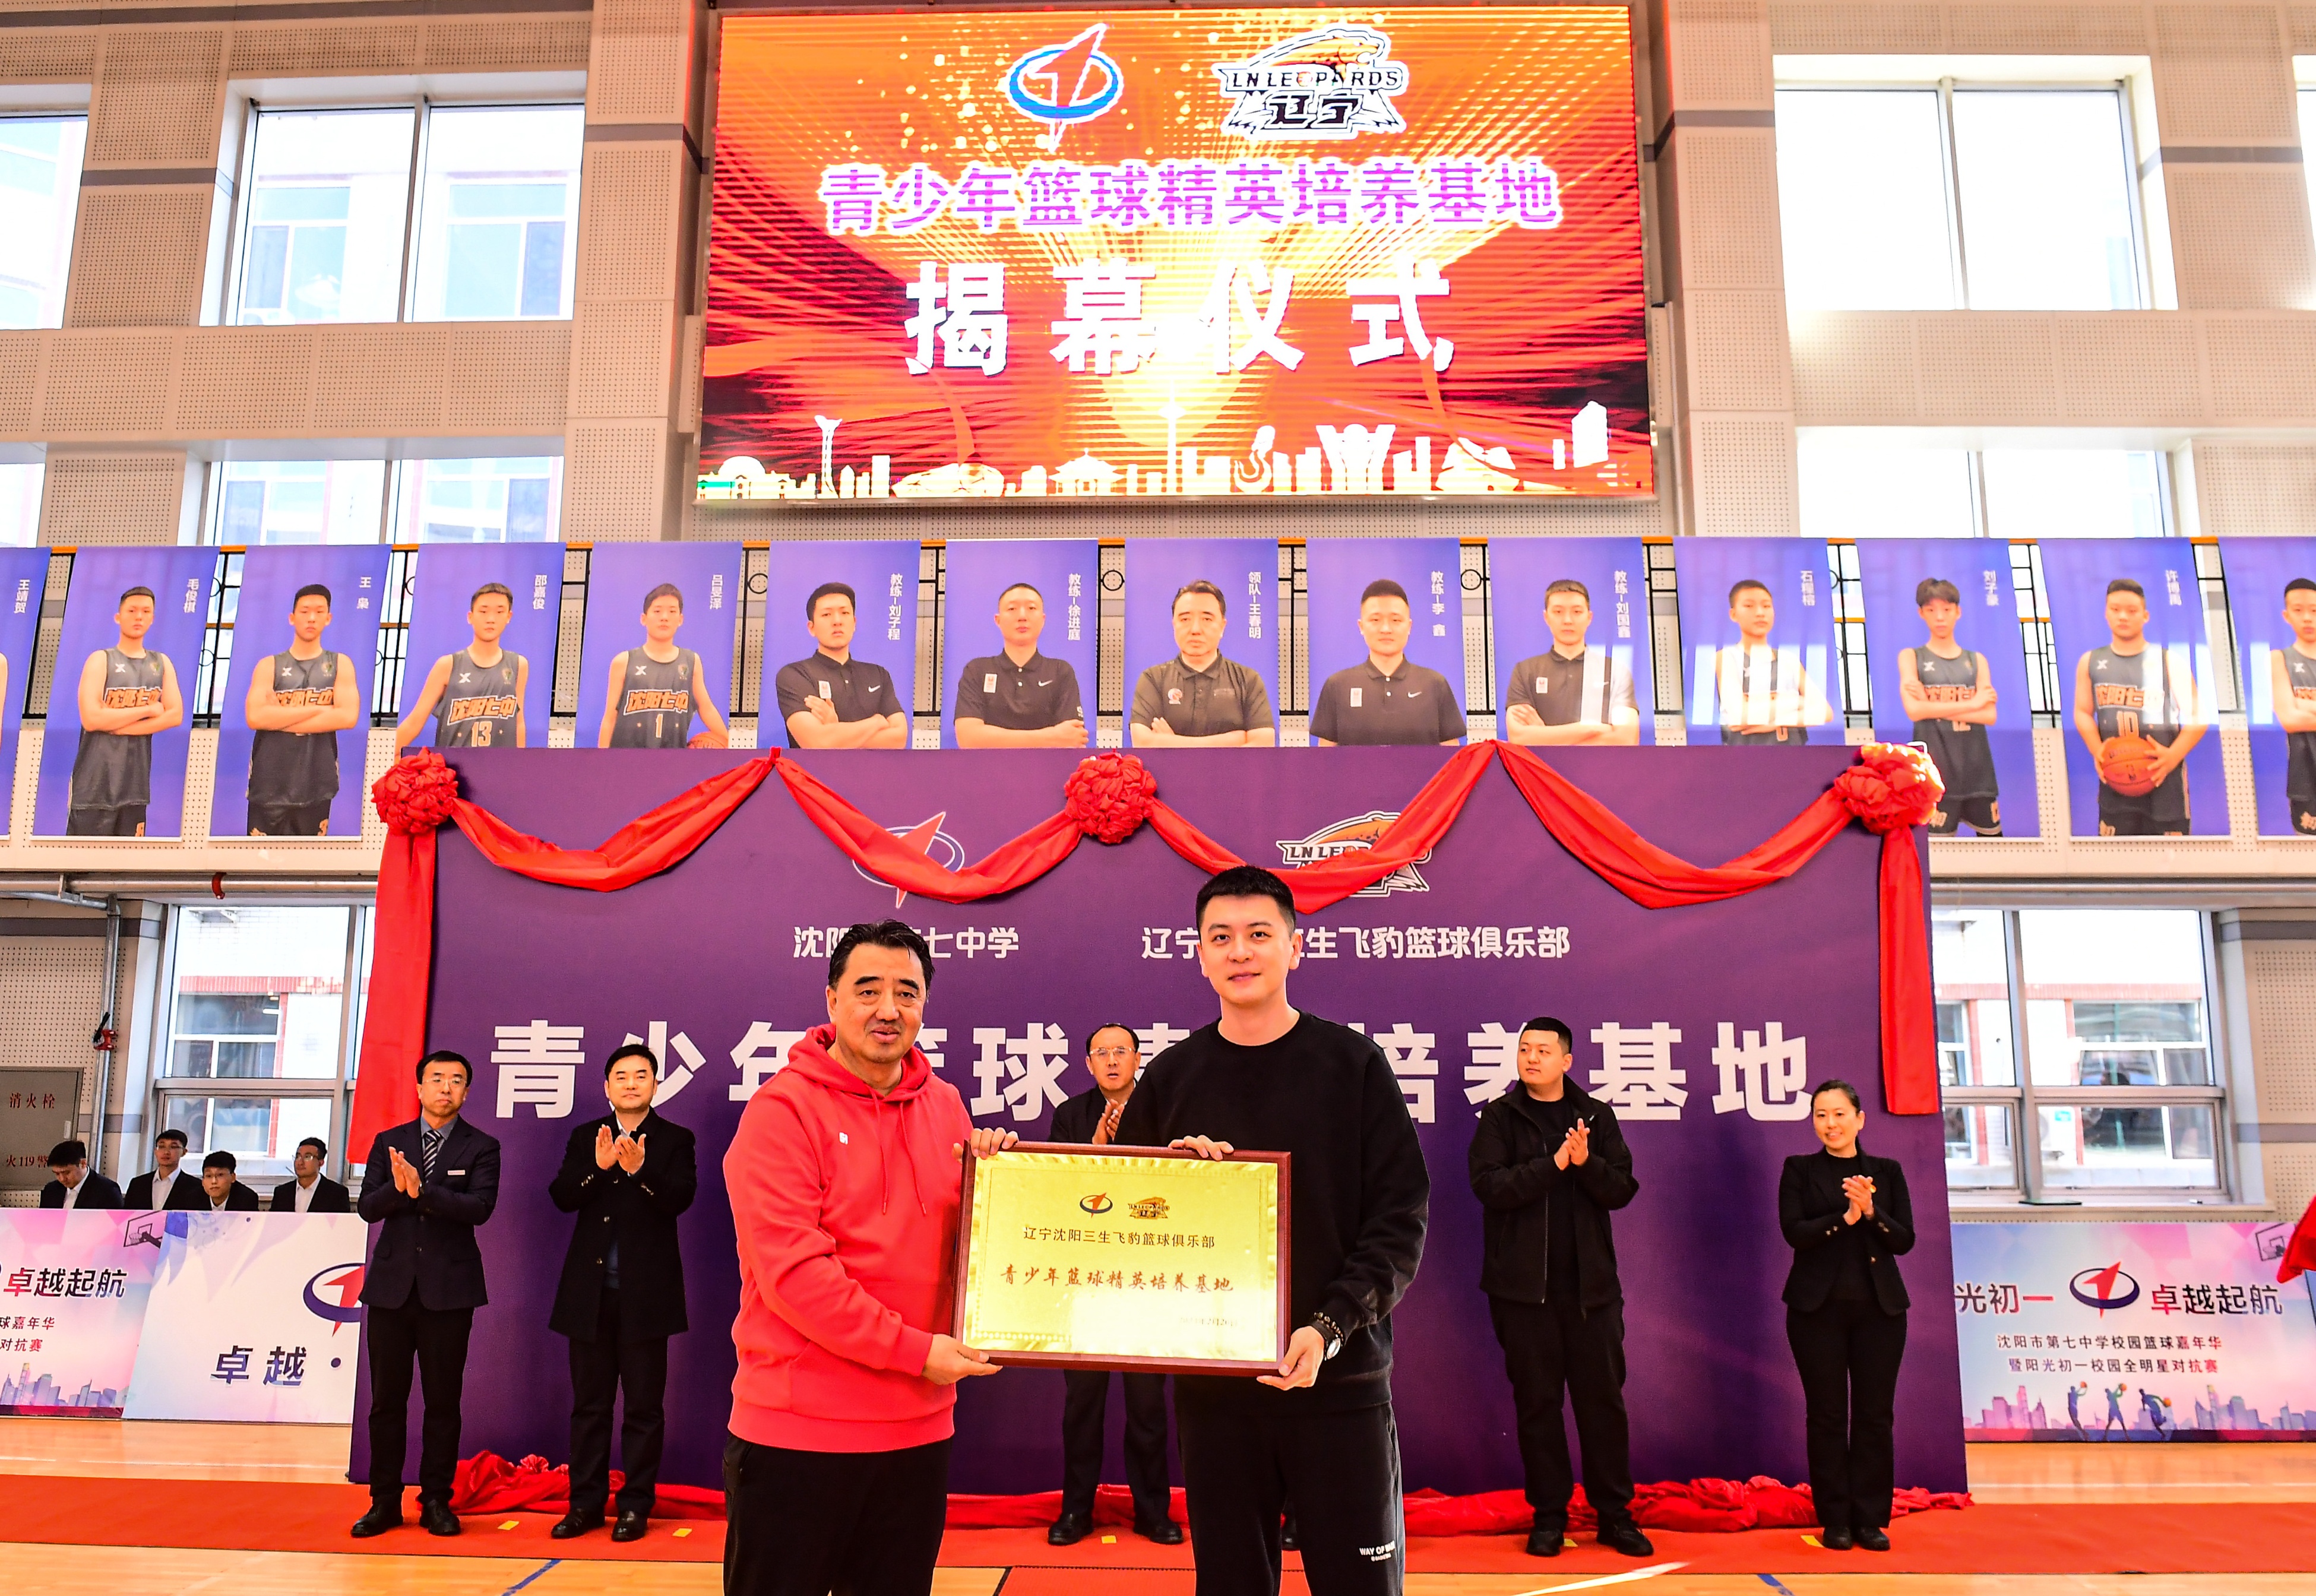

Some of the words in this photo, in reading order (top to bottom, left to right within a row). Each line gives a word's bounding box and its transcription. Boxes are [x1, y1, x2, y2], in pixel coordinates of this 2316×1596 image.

[820, 162, 1563, 234] 青少年篮球精英培养基地
[904, 258, 1454, 376] 揭幕仪式
[448, 695, 517, 725] 沈阳七中
[624, 689, 689, 715] 沈阳七中
[472, 721, 492, 747] 13
[656, 714, 663, 738] 1
[793, 926, 1019, 959] 沈阳七中学
[1141, 926, 1571, 960] 辽宁生飞豹篮球俱乐部
[490, 1019, 1813, 1123] 青少年球培养基地
[10, 1092, 56, 1110] 消火栓
[1023, 1227, 1215, 1249] 辽宁沈阳三生飞豹篮球俱乐部
[3, 1267, 128, 1298] 卓越起航
[1000, 1264, 1233, 1293] 青少年篮球精英培养基地
[1955, 1282, 2054, 1315] 光初一
[2152, 1284, 2283, 1315] 卓越起航
[0, 1338, 43, 1352] 对抗赛
[1997, 1334, 2223, 1351] 沈阳市第七中学校园篮球嘉年华
[2009, 1357, 2219, 1374] 暨阳光初一校园全明星对抗赛
[1359, 1547, 1375, 1556] WAY
